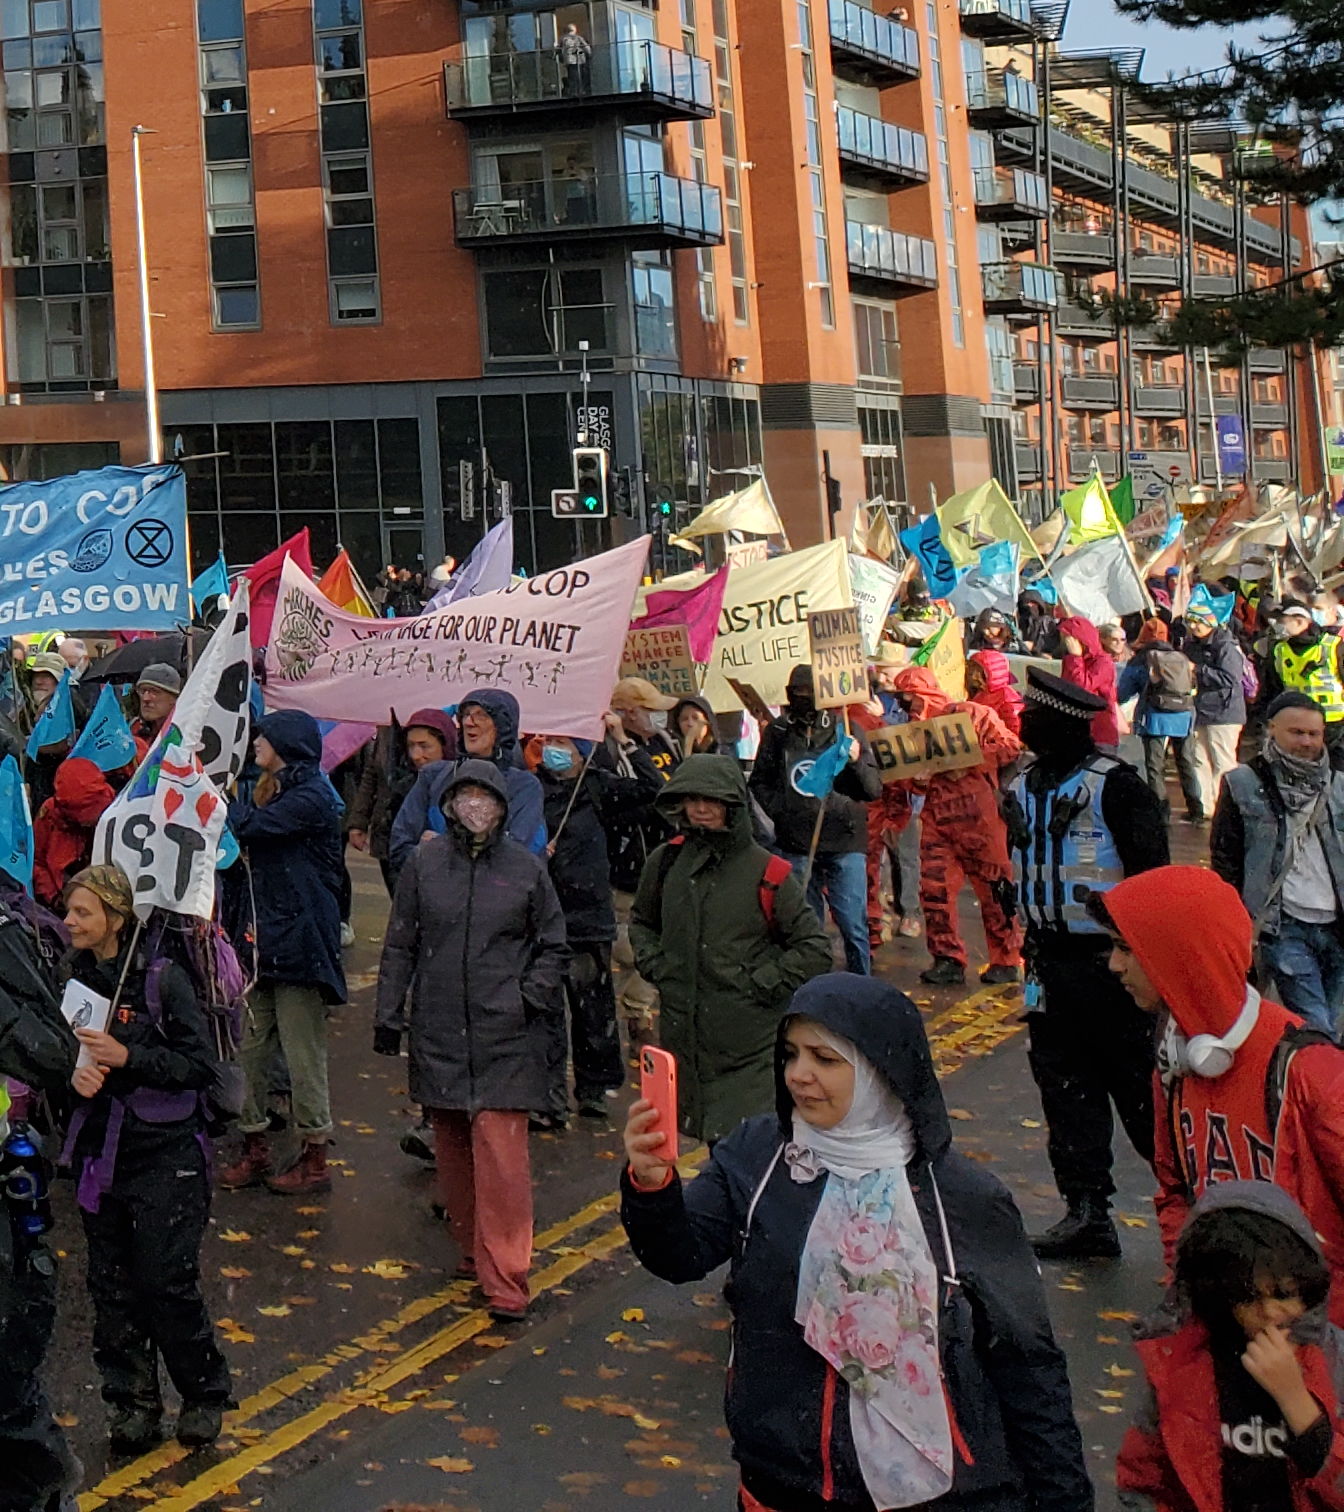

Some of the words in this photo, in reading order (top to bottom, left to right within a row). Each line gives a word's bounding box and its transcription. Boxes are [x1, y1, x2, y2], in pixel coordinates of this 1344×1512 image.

[0, 499, 50, 537] TO
[436, 614, 465, 641] FOR
[465, 616, 496, 645] OUR
[500, 617, 582, 655] PLANET
[717, 590, 809, 638] USTICE
[720, 644, 753, 669] ALL
[761, 635, 801, 663] LIFE
[871, 722, 973, 771] BLAH
